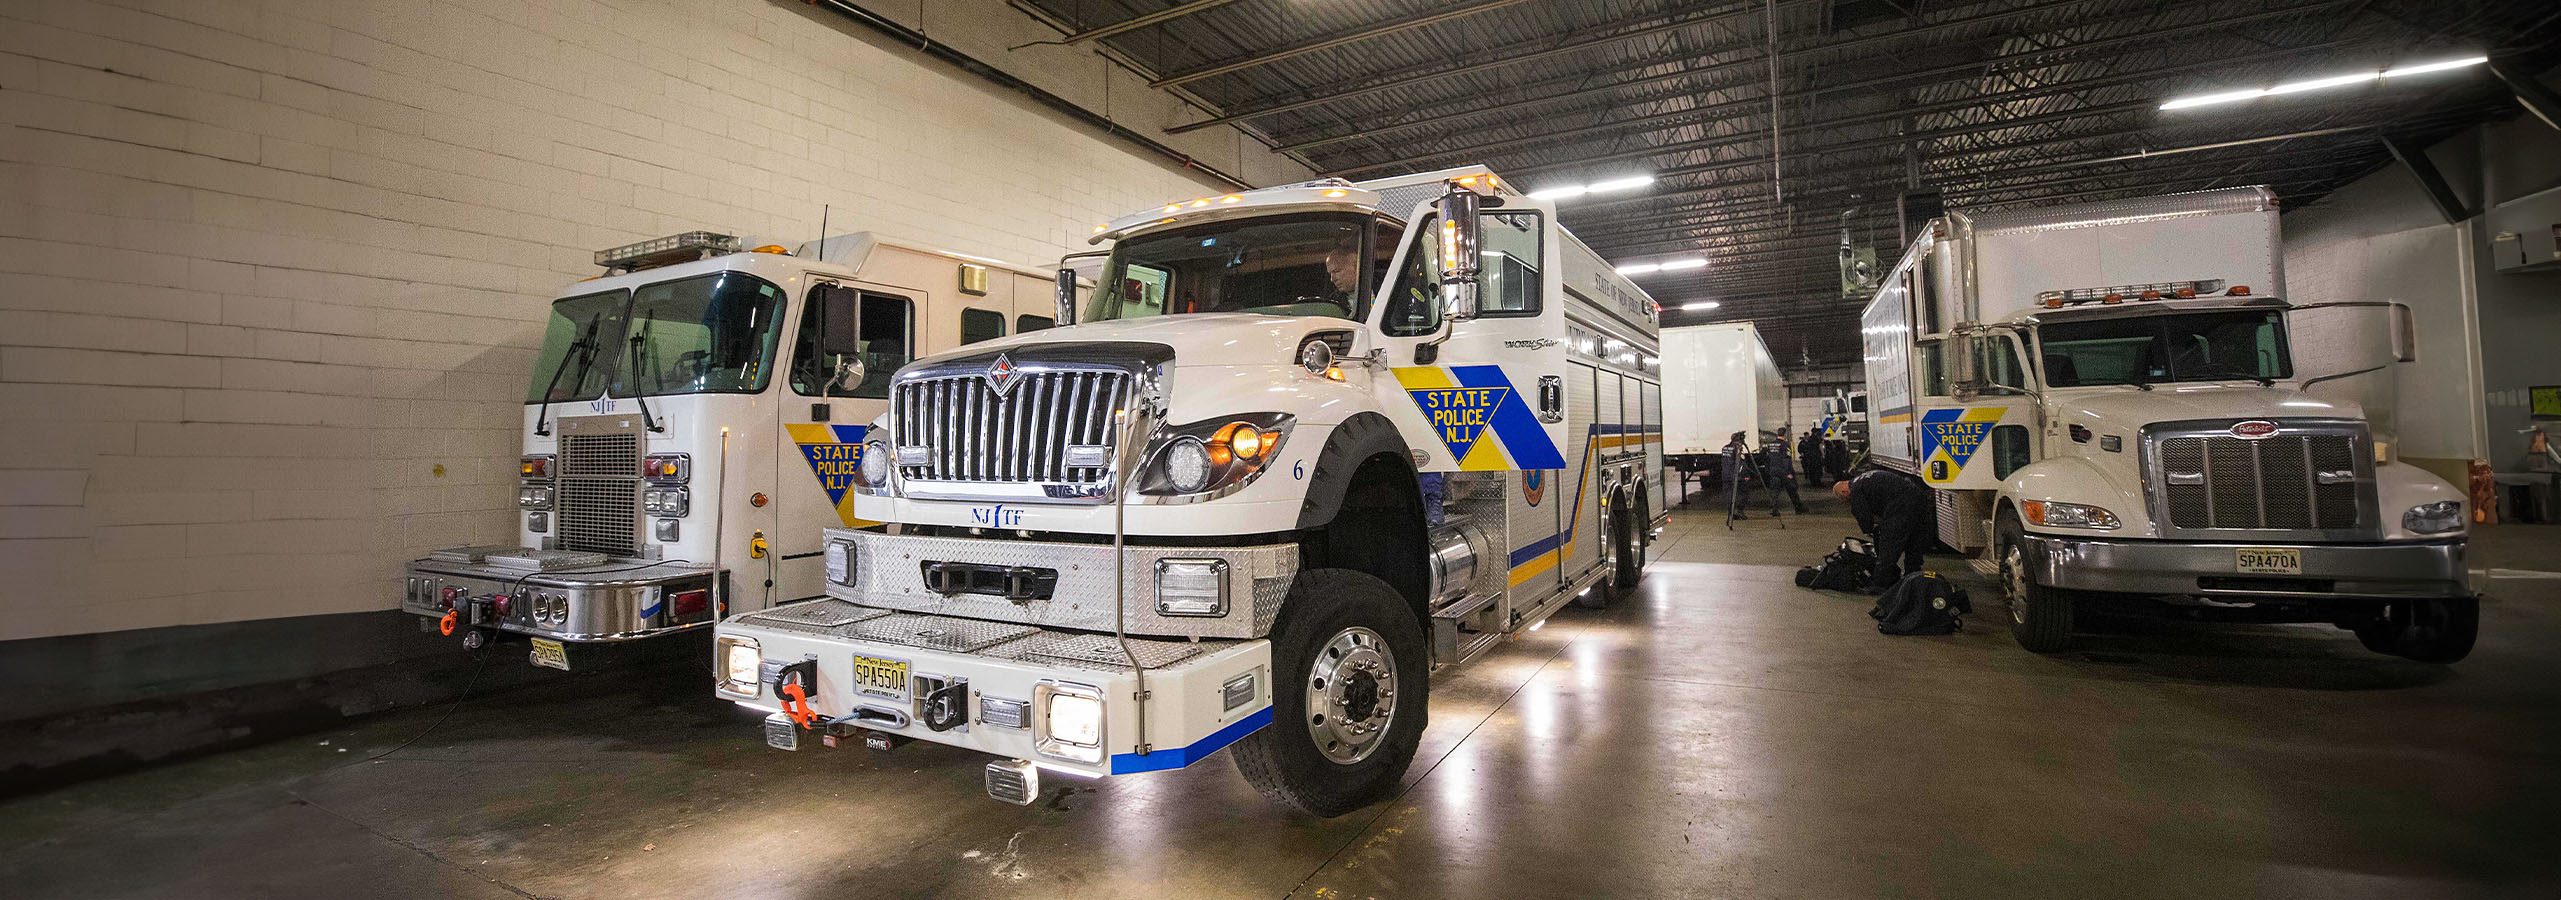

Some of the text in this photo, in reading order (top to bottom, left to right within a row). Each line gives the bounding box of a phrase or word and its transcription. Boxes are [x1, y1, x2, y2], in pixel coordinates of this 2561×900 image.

[1595, 272, 1610, 297] STATE
[1427, 390, 1491, 408] STATE
[1434, 408, 1485, 427] POLICE
[1446, 426, 1472, 443] N.J.
[1936, 423, 1983, 434] STATE
[1941, 435, 1979, 445] POLICE
[812, 446, 861, 460] STATE
[1951, 445, 1970, 456] N.J.
[817, 461, 856, 475] POLICE
[1293, 458, 1303, 480] 6
[826, 475, 846, 490] N.J.
[2240, 554, 2298, 568] SPA470A
[856, 664, 906, 692] SPA550A
